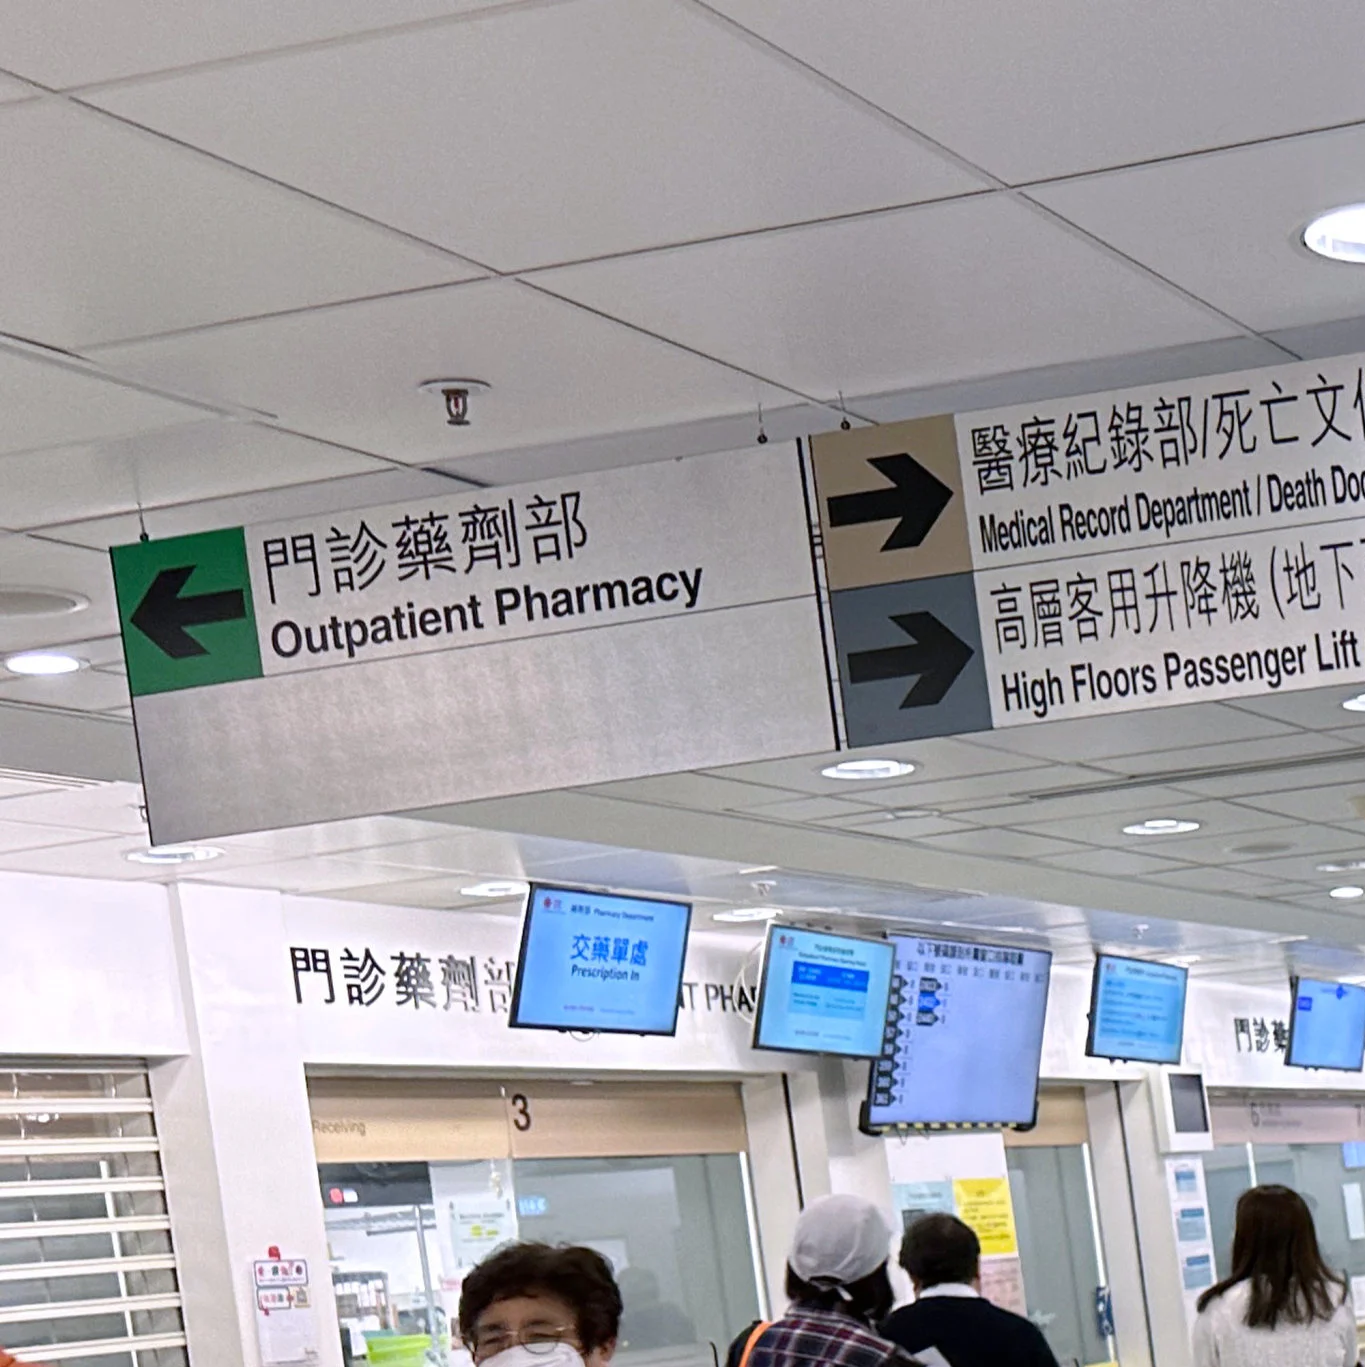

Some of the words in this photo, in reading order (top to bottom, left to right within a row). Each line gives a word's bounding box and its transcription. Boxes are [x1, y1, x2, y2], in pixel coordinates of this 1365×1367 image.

[262, 490, 589, 604] 門診藥劑部
[978, 505, 1056, 553] Medical
[1058, 494, 1132, 542] Record
[1134, 479, 1253, 539] Department
[1266, 468, 1328, 513] Death
[270, 588, 484, 660] Outpatient
[494, 565, 704, 627] Pharmacy
[1001, 668, 1064, 719] High
[1070, 661, 1157, 703] Floors
[1163, 642, 1307, 689] Passenger
[1314, 629, 1361, 672] Lift
[571, 934, 648, 966] 交藥單處
[571, 965, 628, 981] Prescription
[630, 970, 640, 981] In
[511, 1093, 531, 1132] 3
